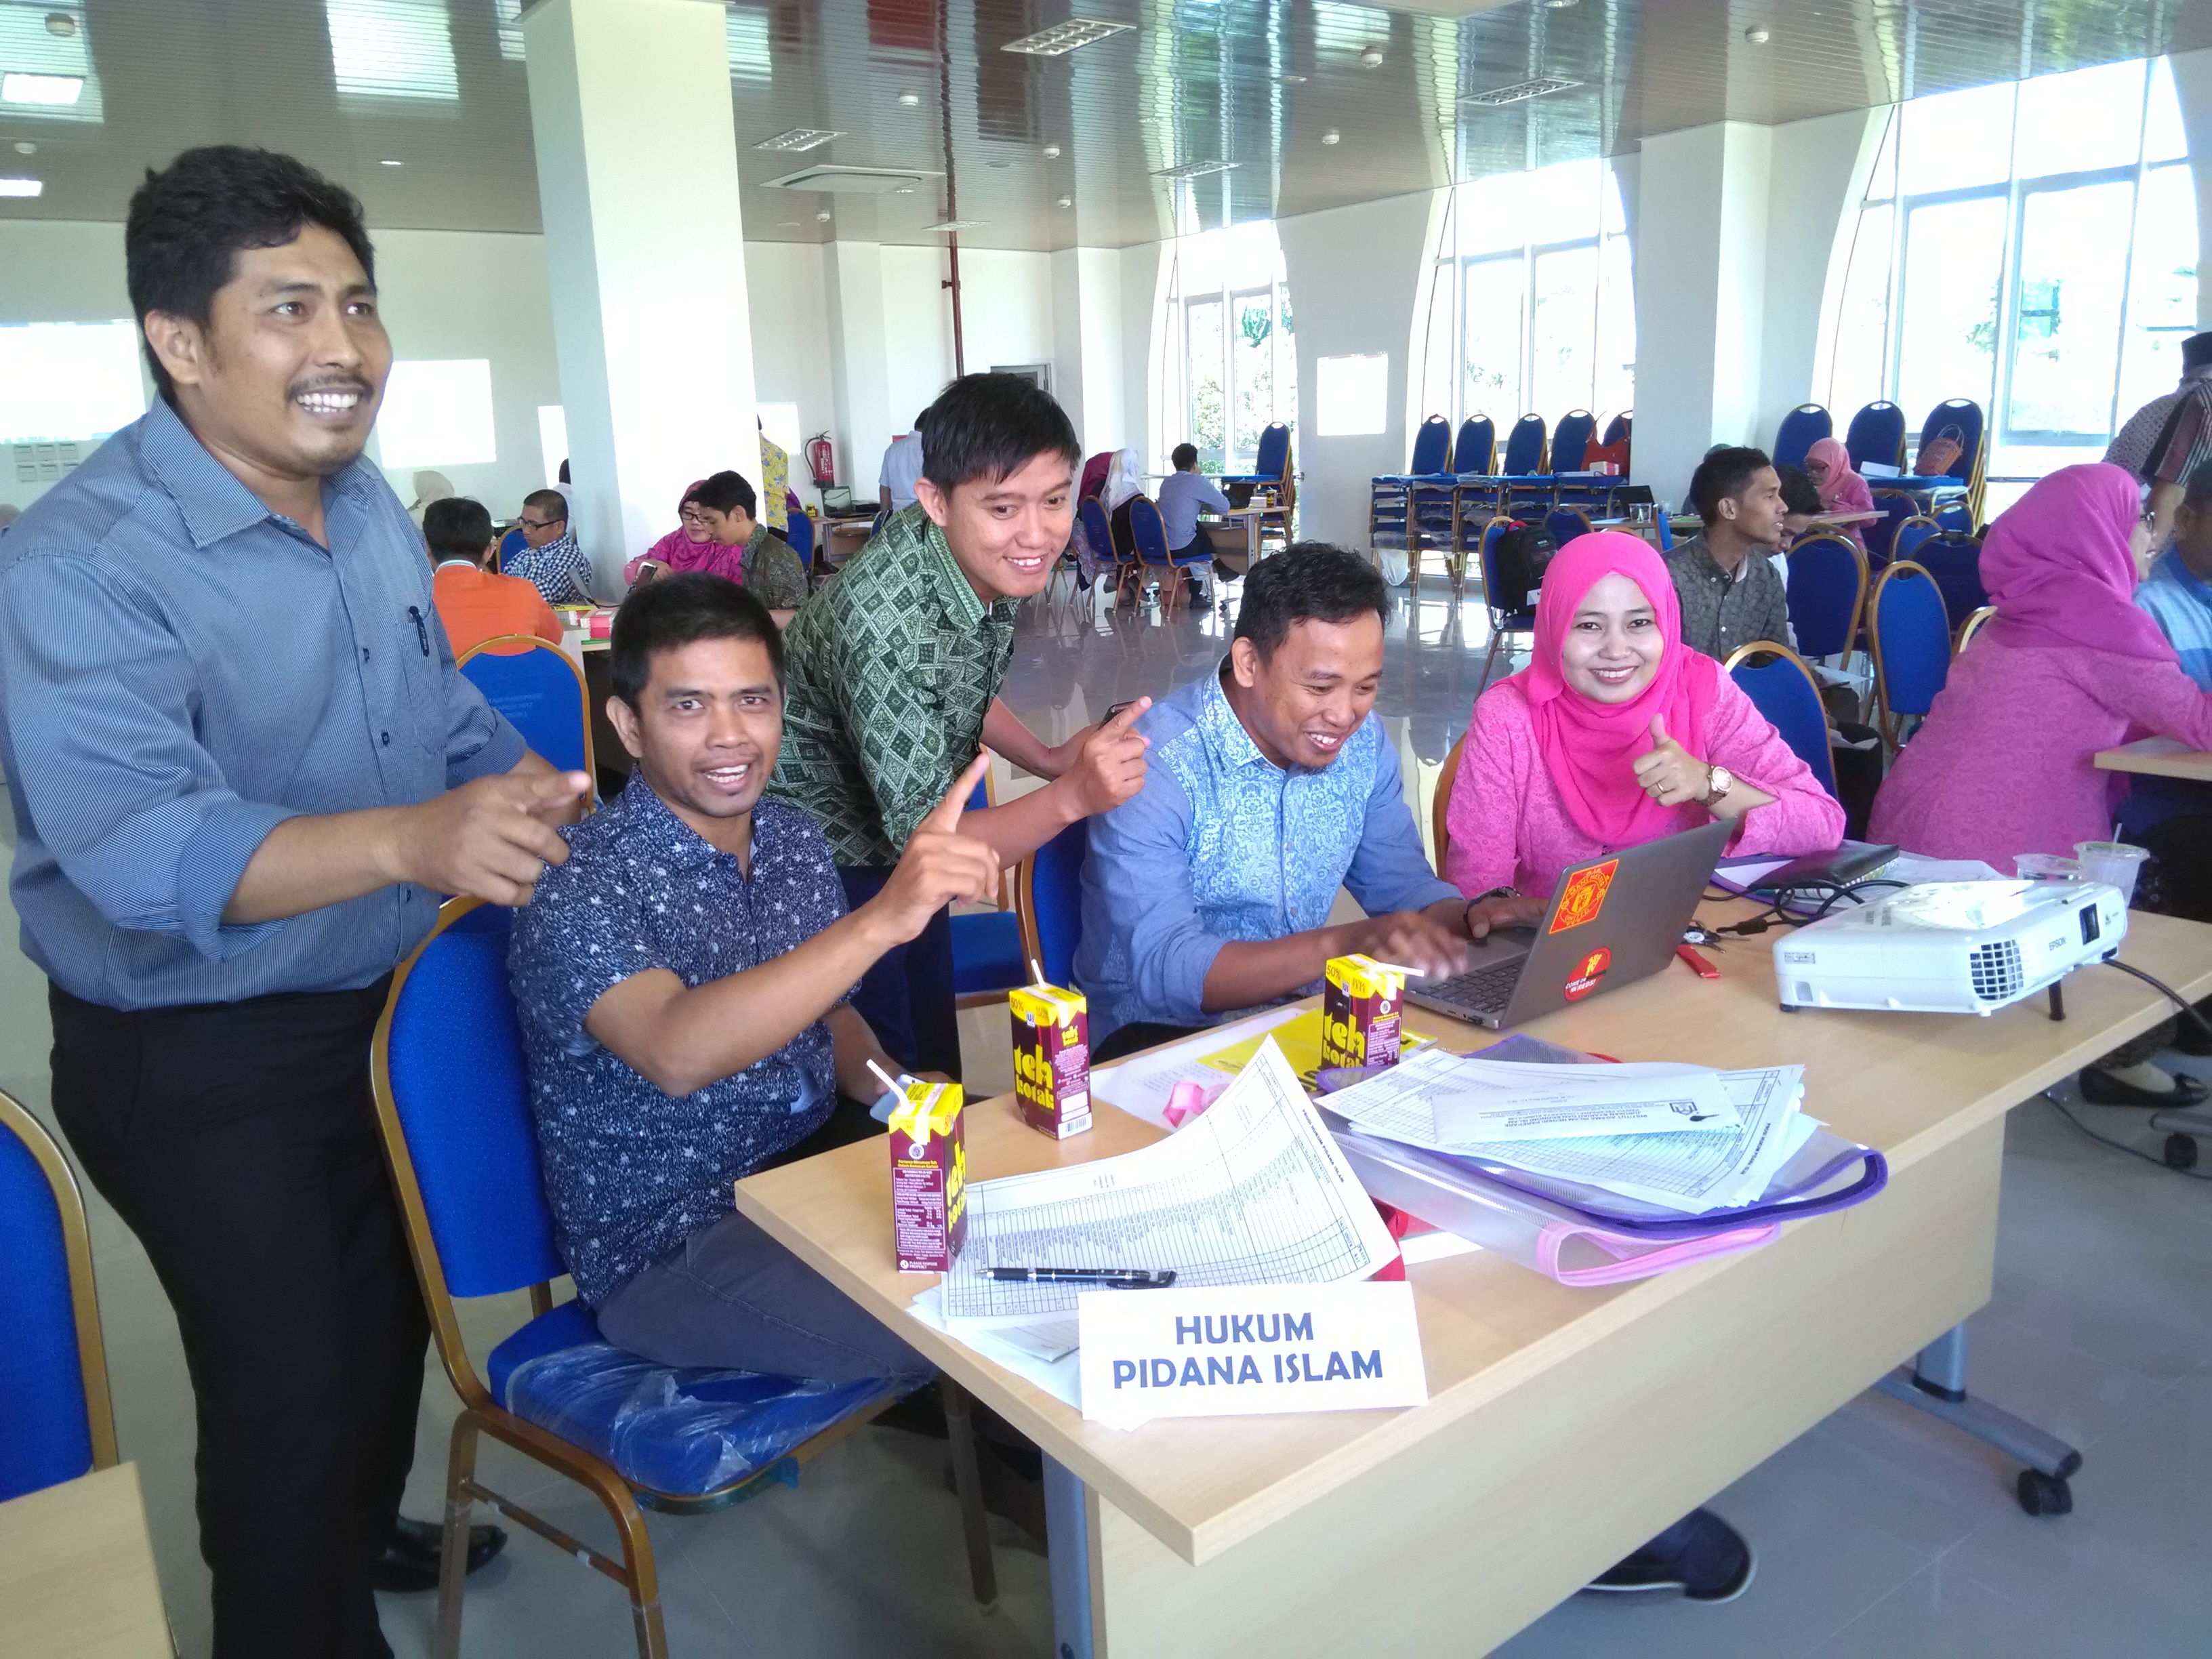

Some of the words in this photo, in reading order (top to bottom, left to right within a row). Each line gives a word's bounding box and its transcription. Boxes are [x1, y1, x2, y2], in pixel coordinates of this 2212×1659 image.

[2049, 937, 2066, 951] EPSON
[1327, 965, 1341, 980] 50%
[1011, 997, 1024, 1011] 50%
[1324, 1012, 1365, 1059] teh
[1014, 1044, 1053, 1090] teh
[1016, 1073, 1054, 1110] kotak
[1302, 1109, 1312, 1125] PRODI
[1311, 1125, 1323, 1145] HUKUM
[1322, 1145, 1334, 1166] PIDANA
[1334, 1166, 1344, 1183] ISLAM
[1176, 1312, 1313, 1345] HUKUM
[1113, 1355, 1263, 1389] PIDANA
[1274, 1350, 1382, 1383] ISLAM
